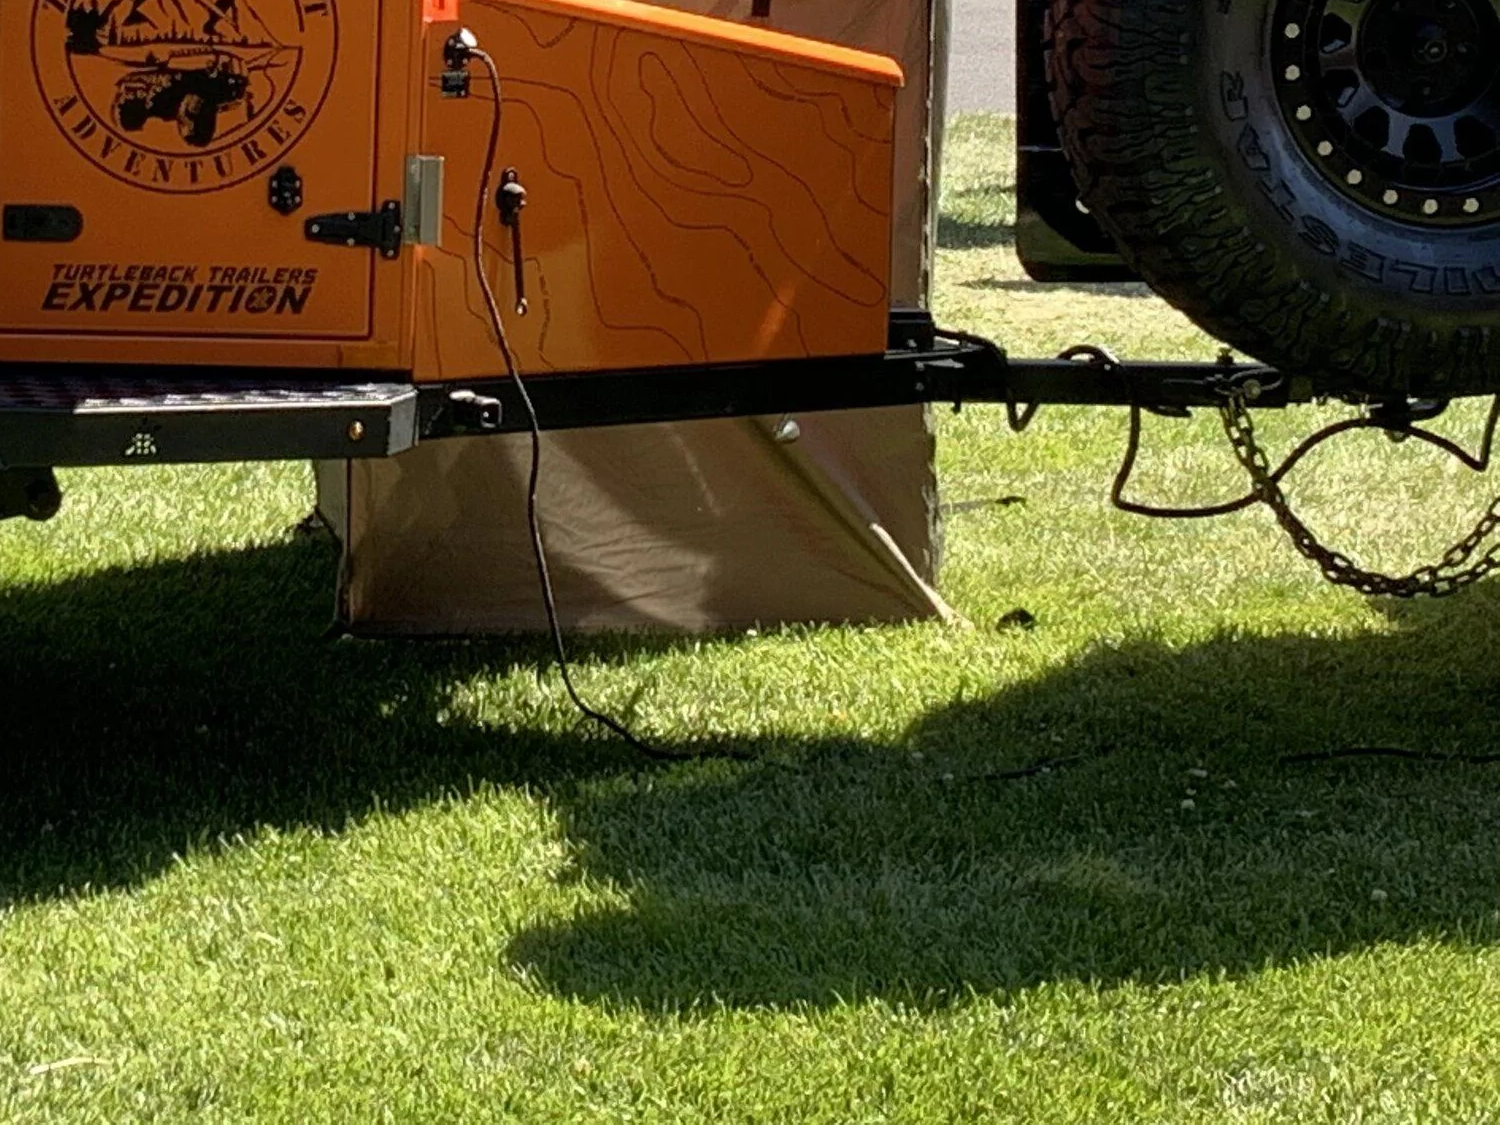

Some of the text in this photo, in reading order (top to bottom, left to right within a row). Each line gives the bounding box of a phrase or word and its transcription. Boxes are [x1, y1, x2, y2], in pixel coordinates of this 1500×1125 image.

[52, 93, 308, 185] ADVENTURES
[51, 263, 319, 285] TURTLEBACK TRAILERS
[40, 281, 313, 315] EXPEDITION
